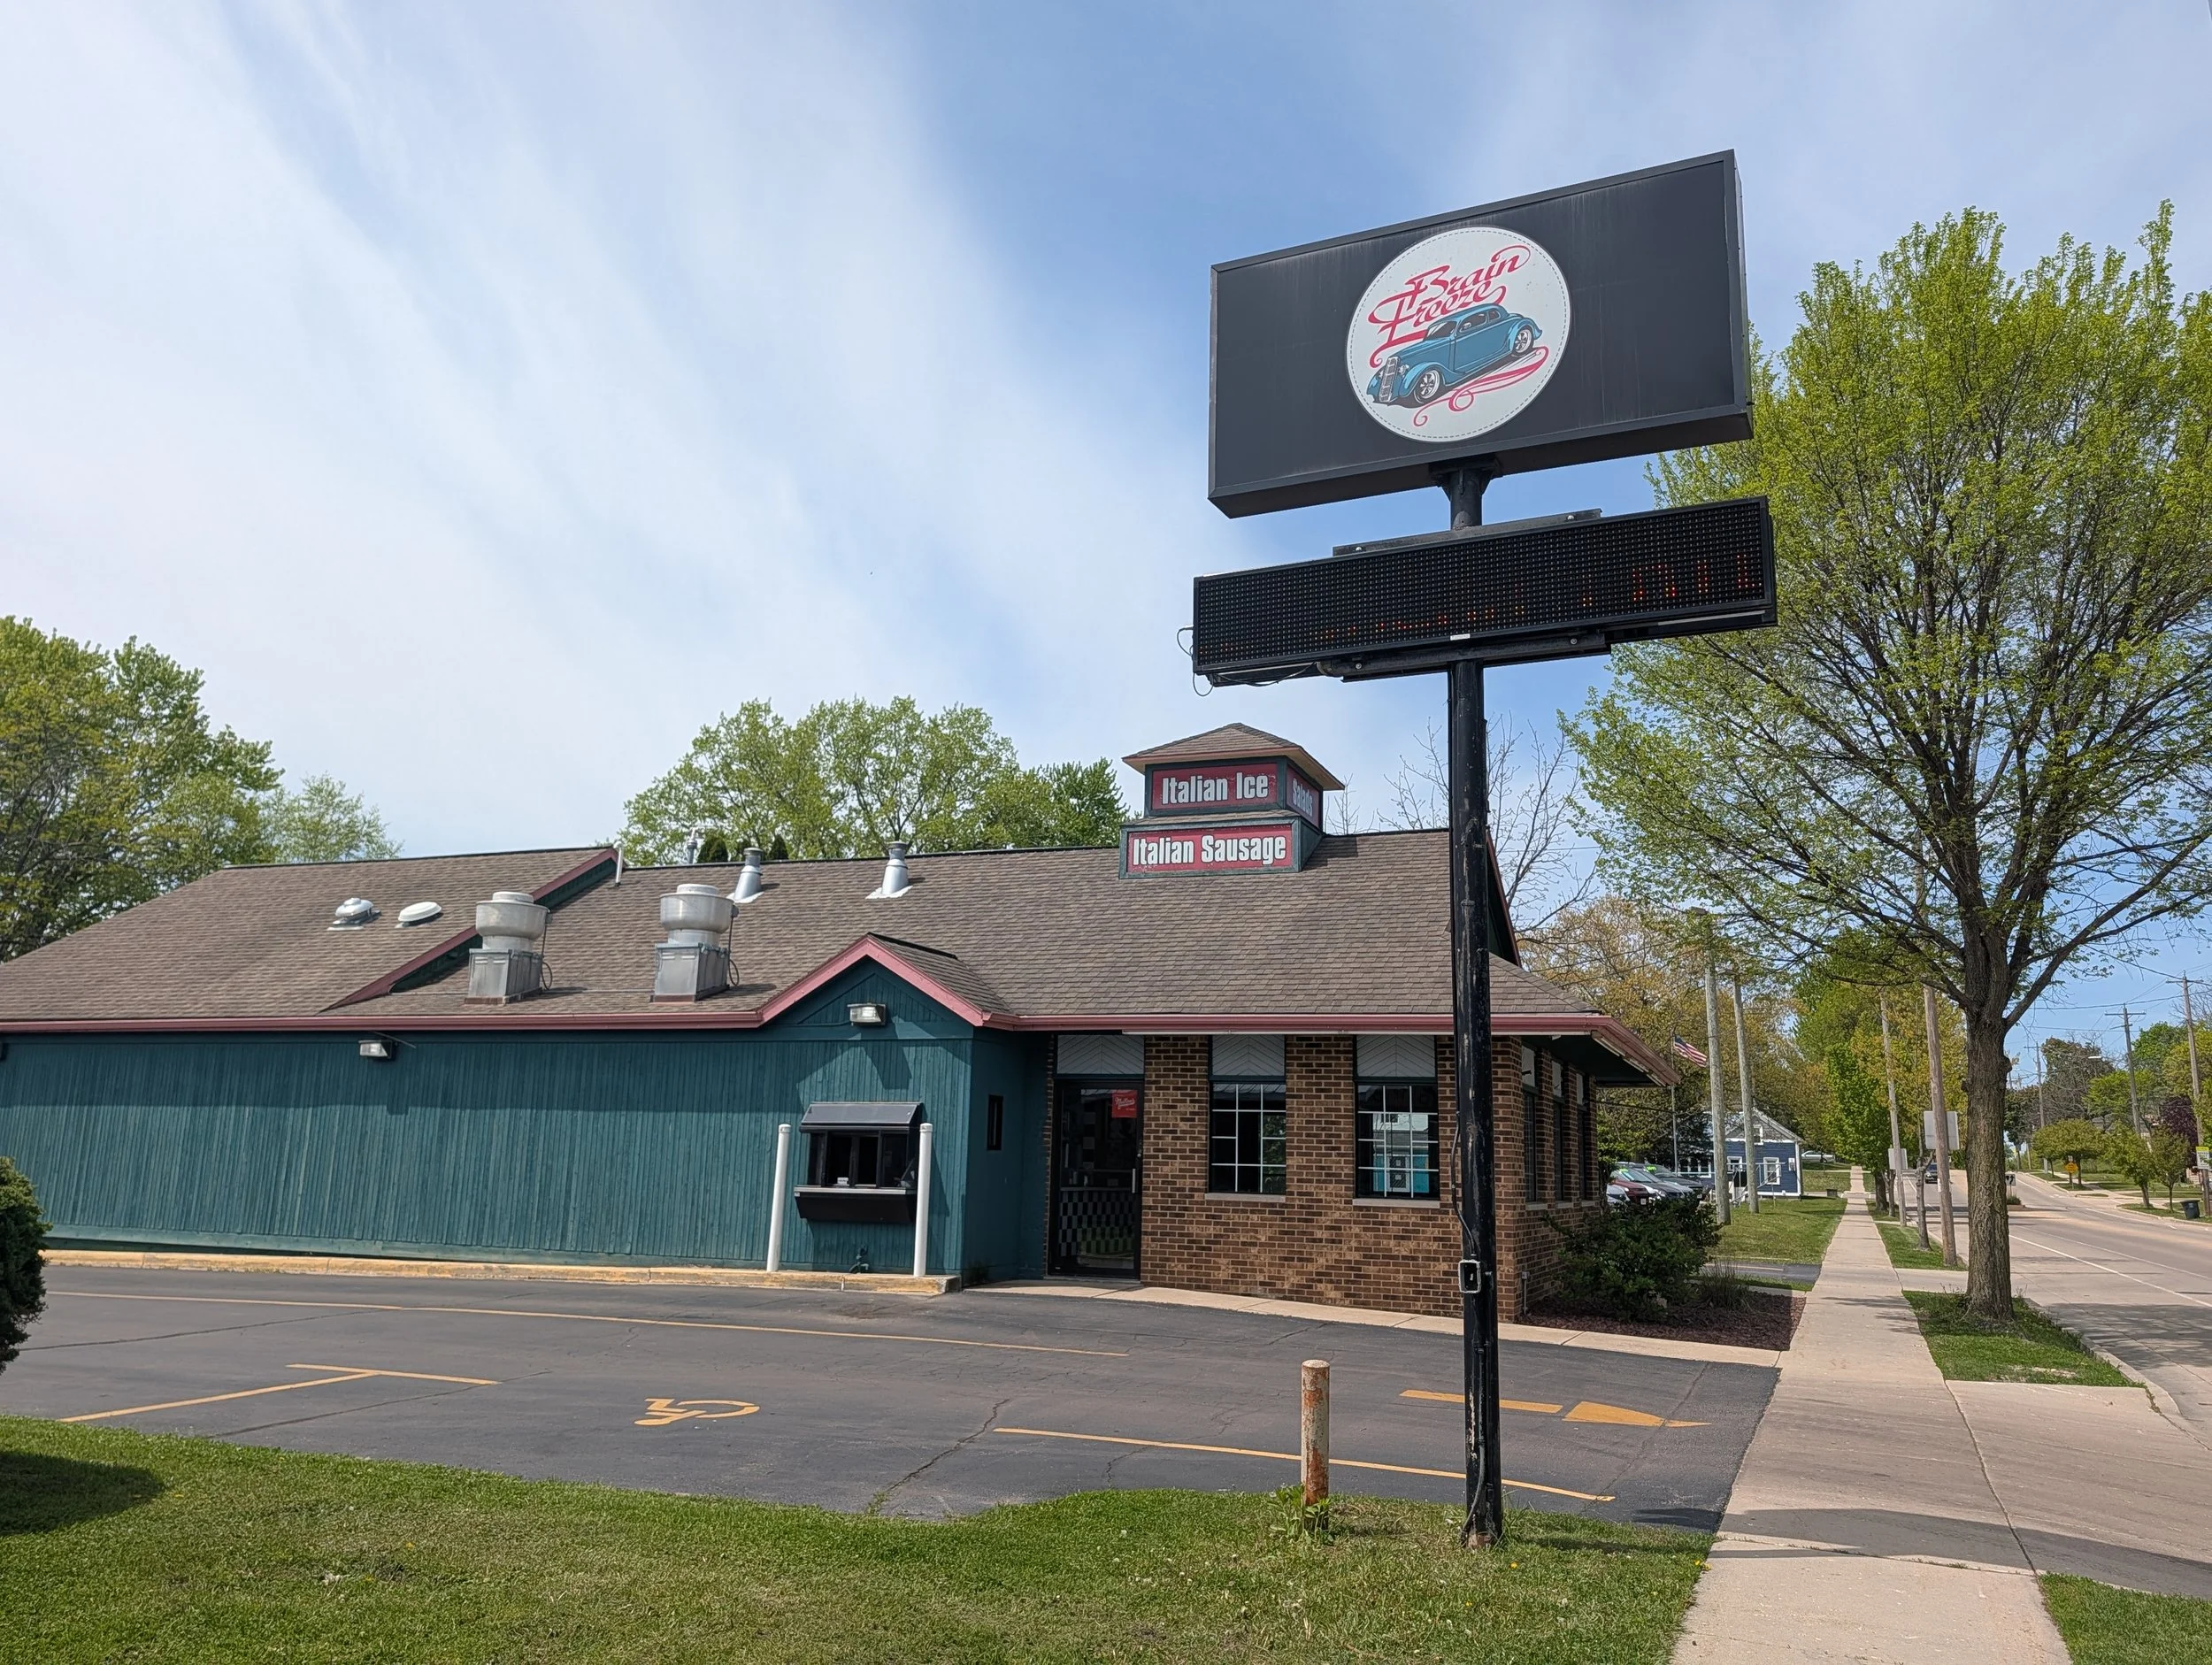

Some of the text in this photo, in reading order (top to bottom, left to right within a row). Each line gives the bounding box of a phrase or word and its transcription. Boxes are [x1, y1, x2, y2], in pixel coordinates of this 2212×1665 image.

[1404, 245, 1532, 311] Brain
[1368, 281, 1507, 368] Freeze
[1161, 771, 1269, 805] Italian Ice
[1293, 778, 1313, 817] Salads
[1133, 834, 1286, 866] Italian Sausage
